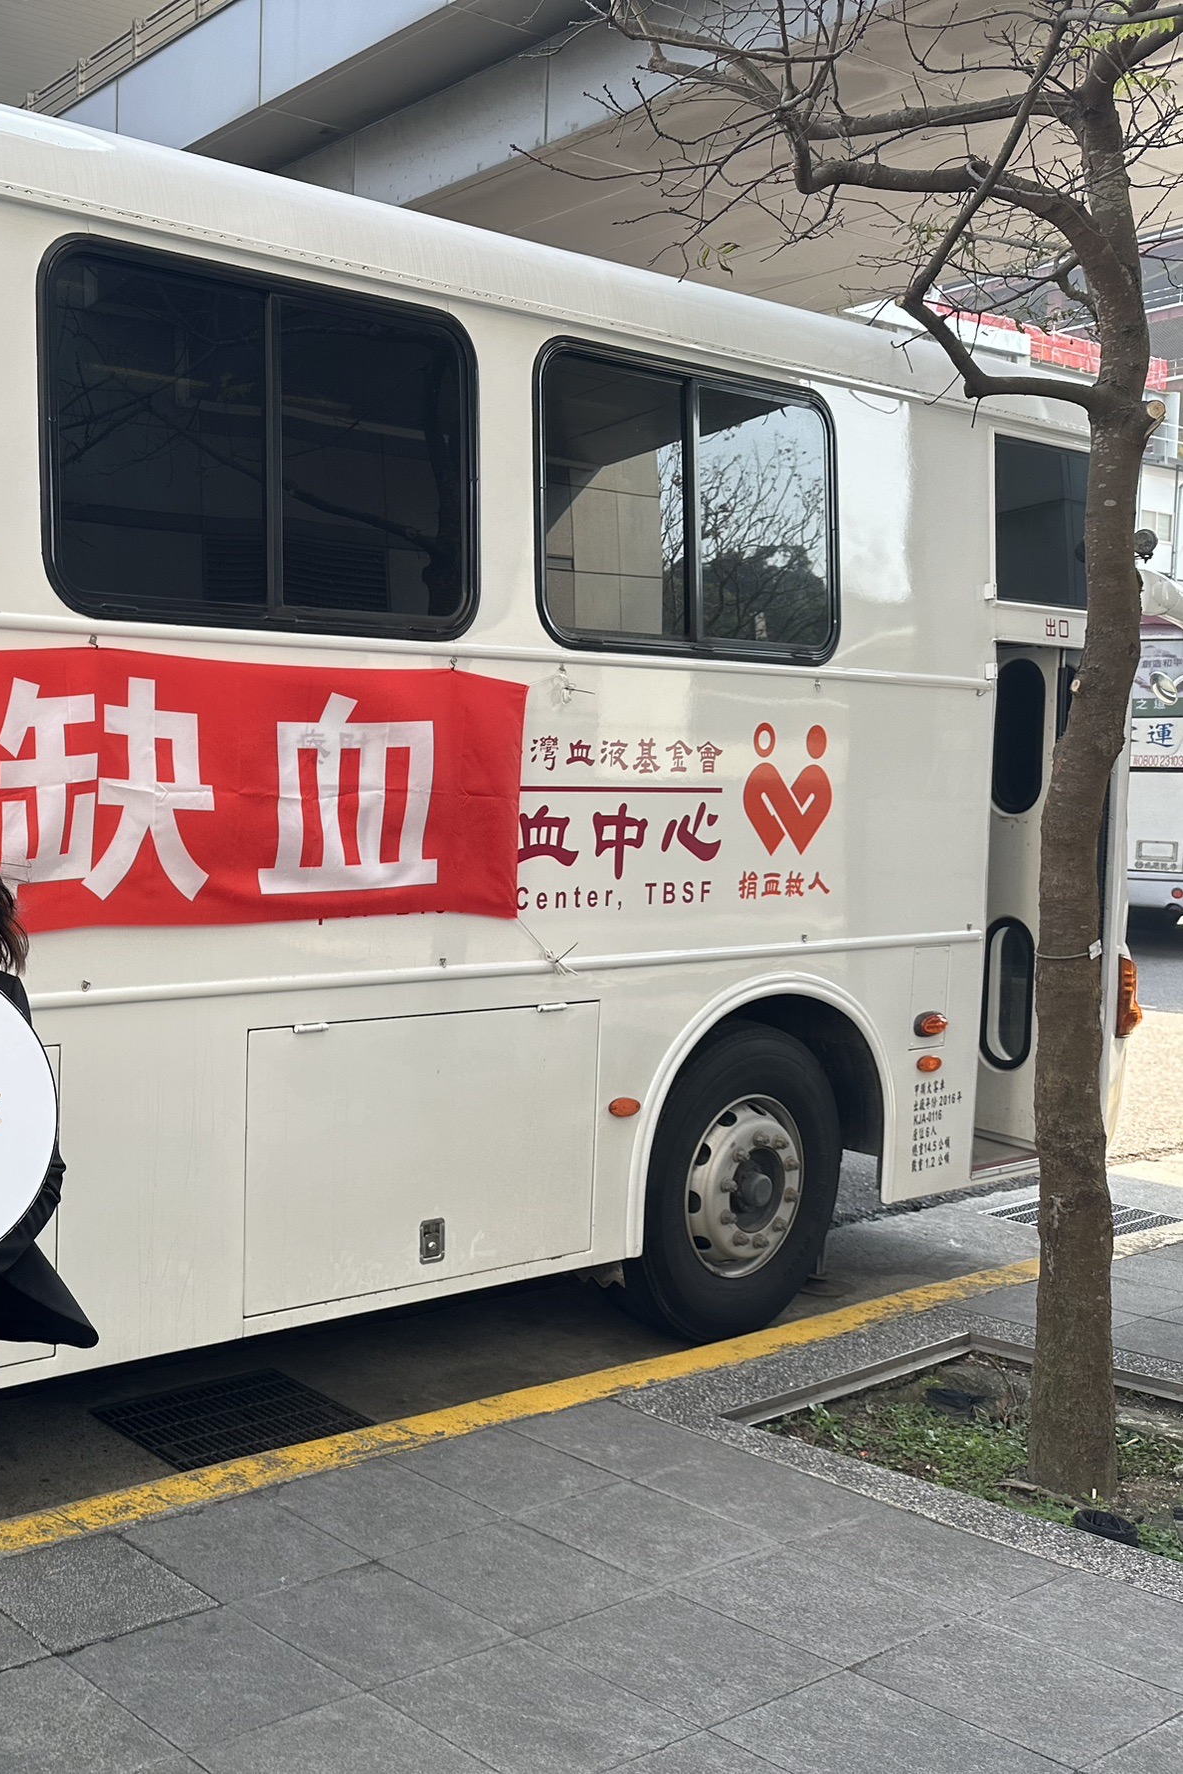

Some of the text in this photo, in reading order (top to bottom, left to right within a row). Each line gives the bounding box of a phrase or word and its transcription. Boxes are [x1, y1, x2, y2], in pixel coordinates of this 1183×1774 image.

[1045, 618, 1069, 638] 出口
[530, 735, 723, 774] 灣血液基金會
[517, 801, 722, 880] 血中心
[517, 880, 712, 911] Center, TBSF
[738, 870, 830, 900] 捐血救人
